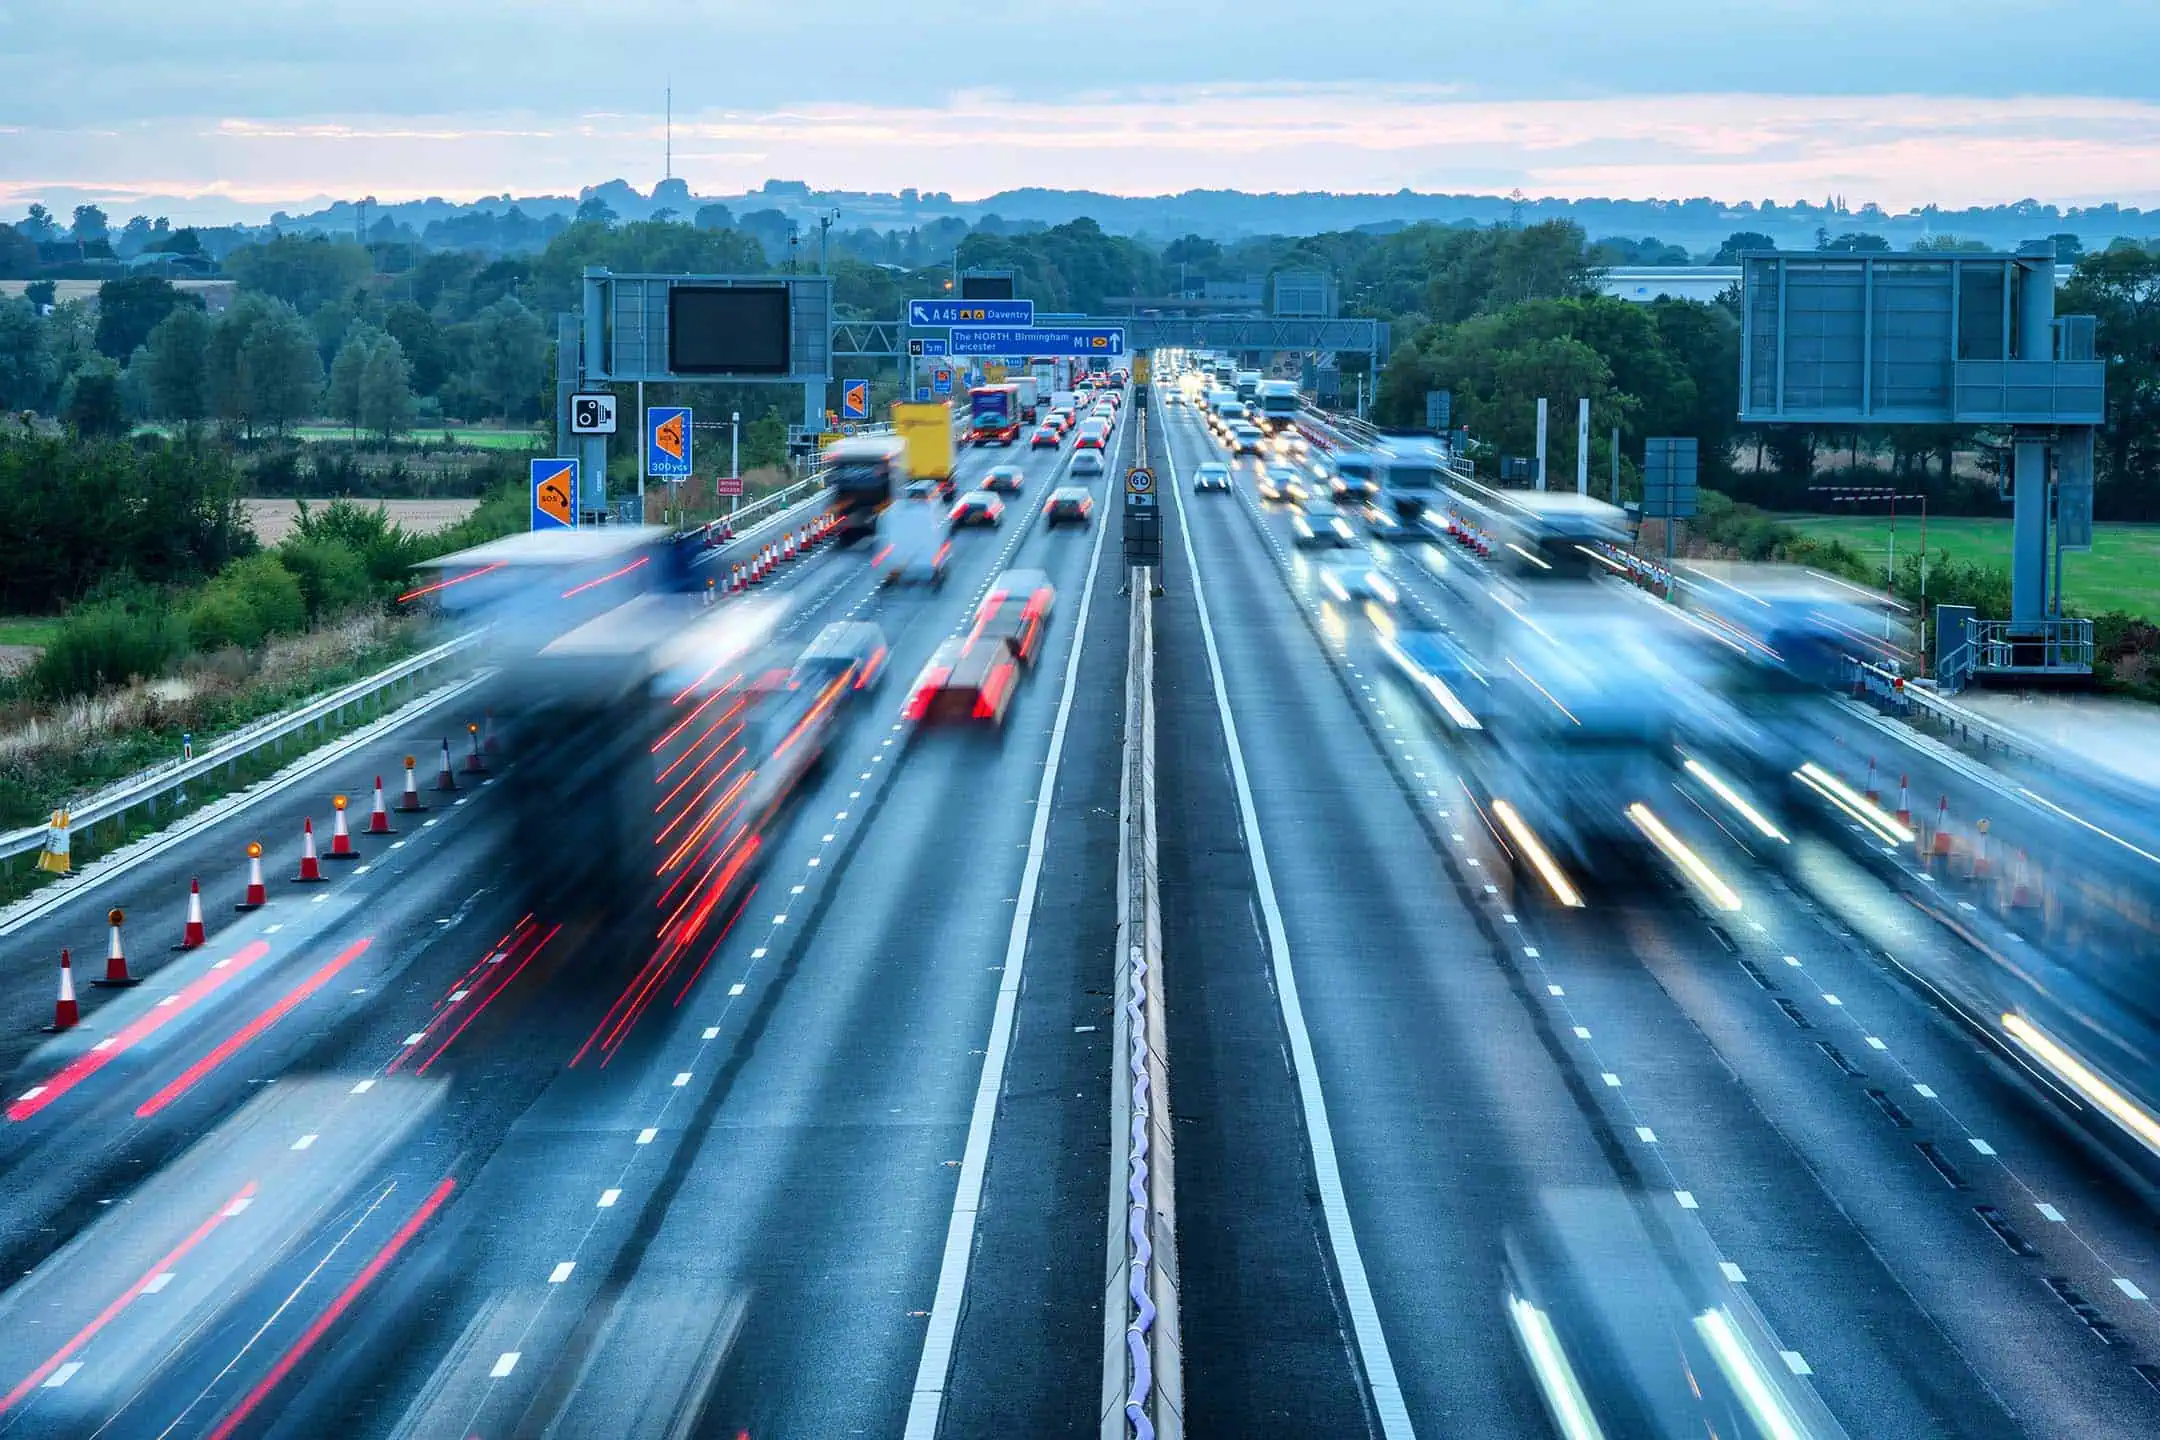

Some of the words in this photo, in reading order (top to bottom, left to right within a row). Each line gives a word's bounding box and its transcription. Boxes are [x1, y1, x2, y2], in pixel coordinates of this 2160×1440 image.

[987, 310, 1029, 320] Daventry
[954, 332, 971, 341] The
[1015, 332, 1069, 343] Birmingham
[955, 343, 996, 351] Leicester
[652, 462, 671, 471] 300
[1133, 475, 1148, 485] 60
